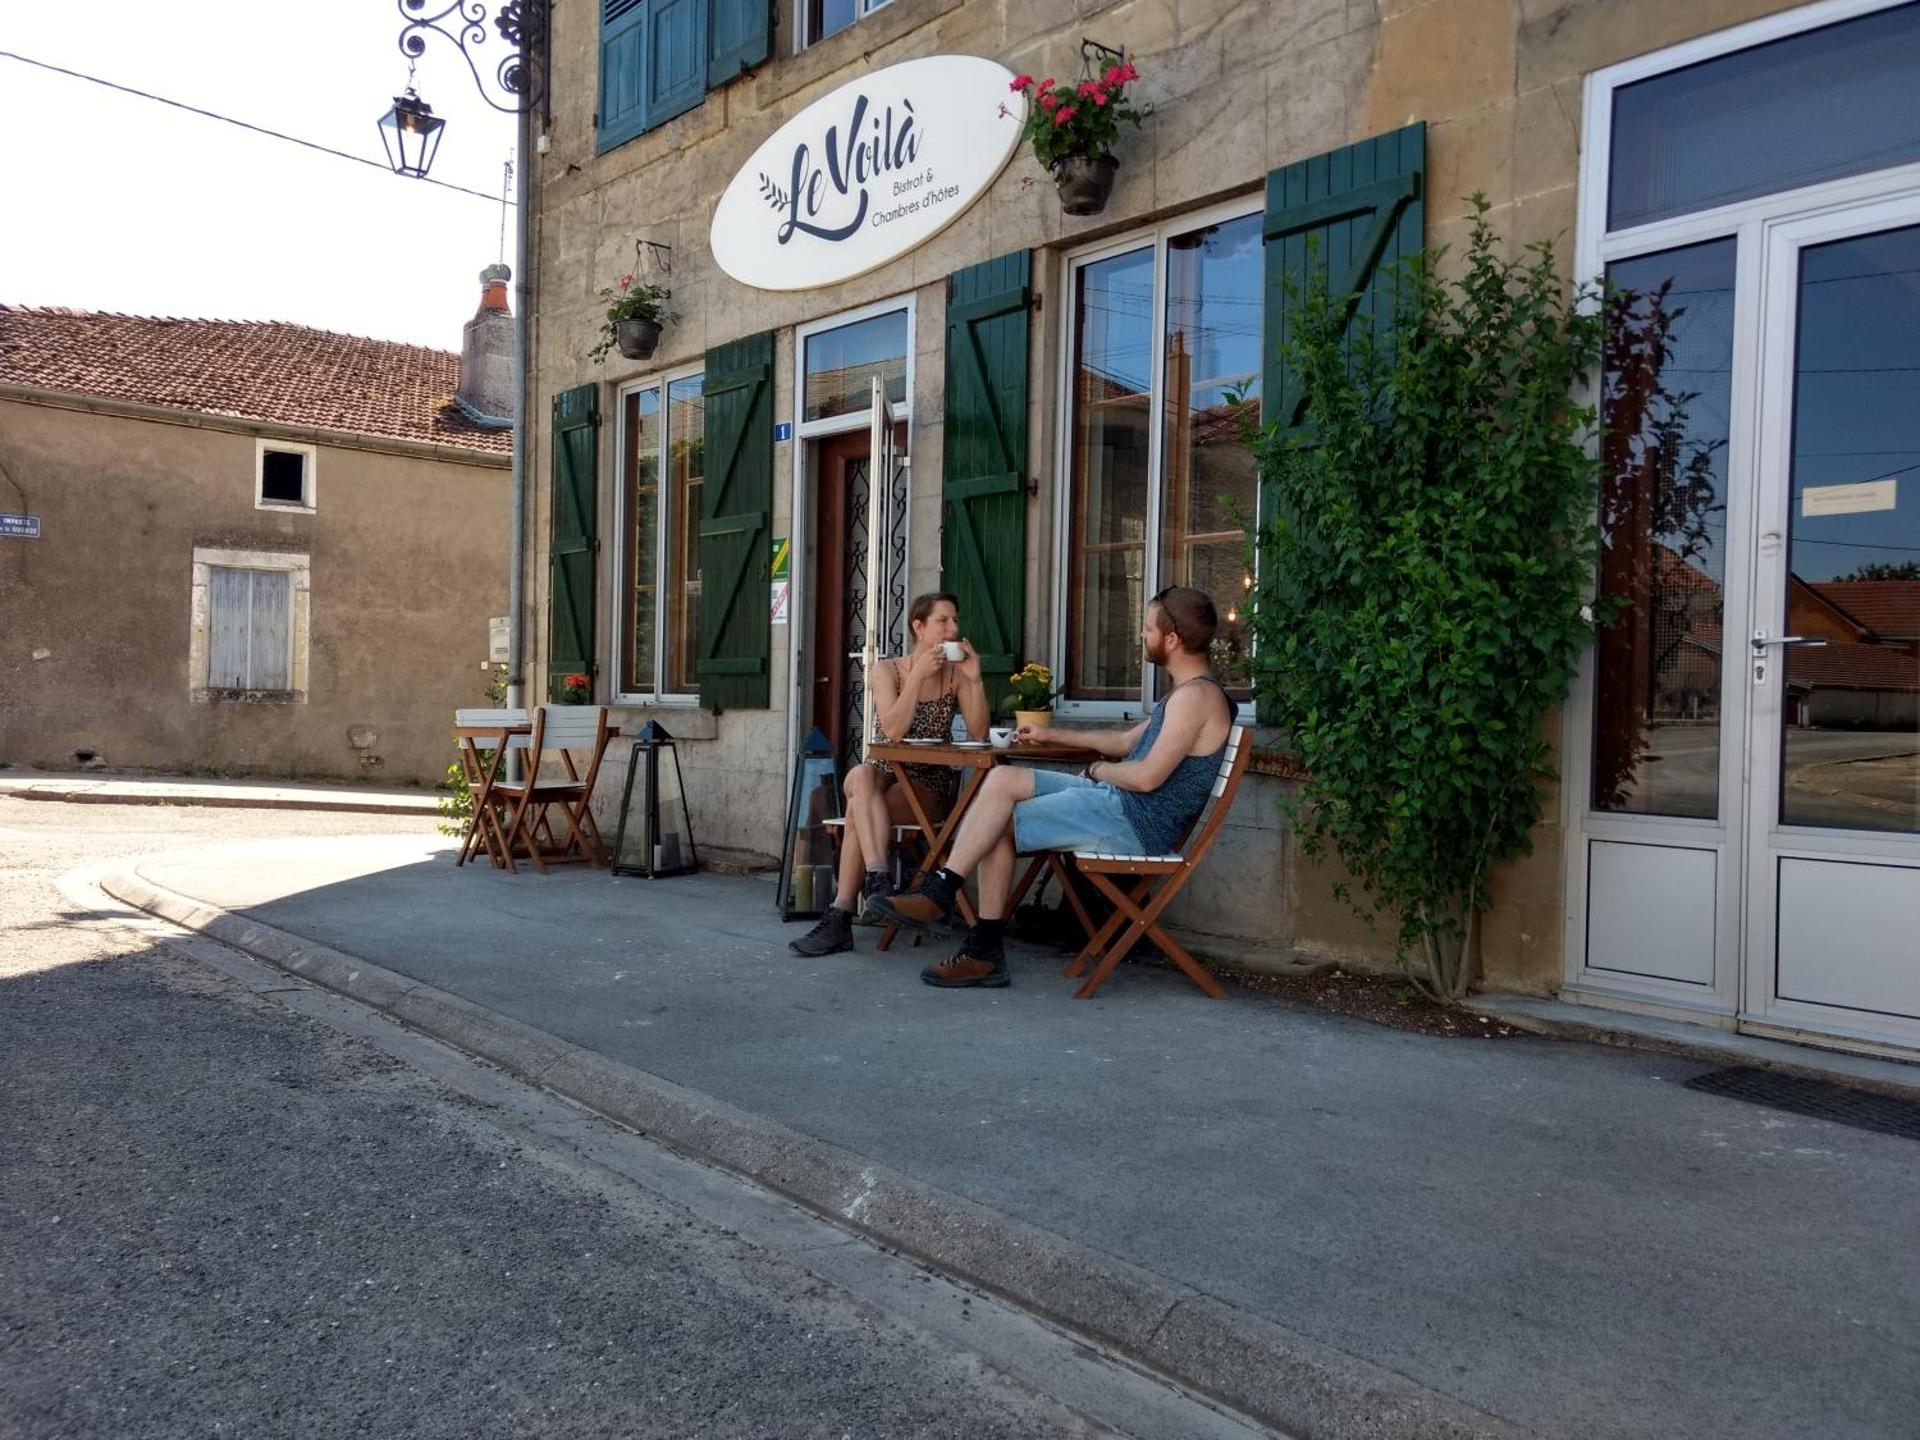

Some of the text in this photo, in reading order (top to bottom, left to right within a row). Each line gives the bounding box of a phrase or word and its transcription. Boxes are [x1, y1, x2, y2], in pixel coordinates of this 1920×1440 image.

[825, 94, 923, 195] Voilà
[893, 167, 934, 197] Bistrot &
[872, 184, 960, 228] Chambres d'hôtes
[780, 425, 786, 440] 1
